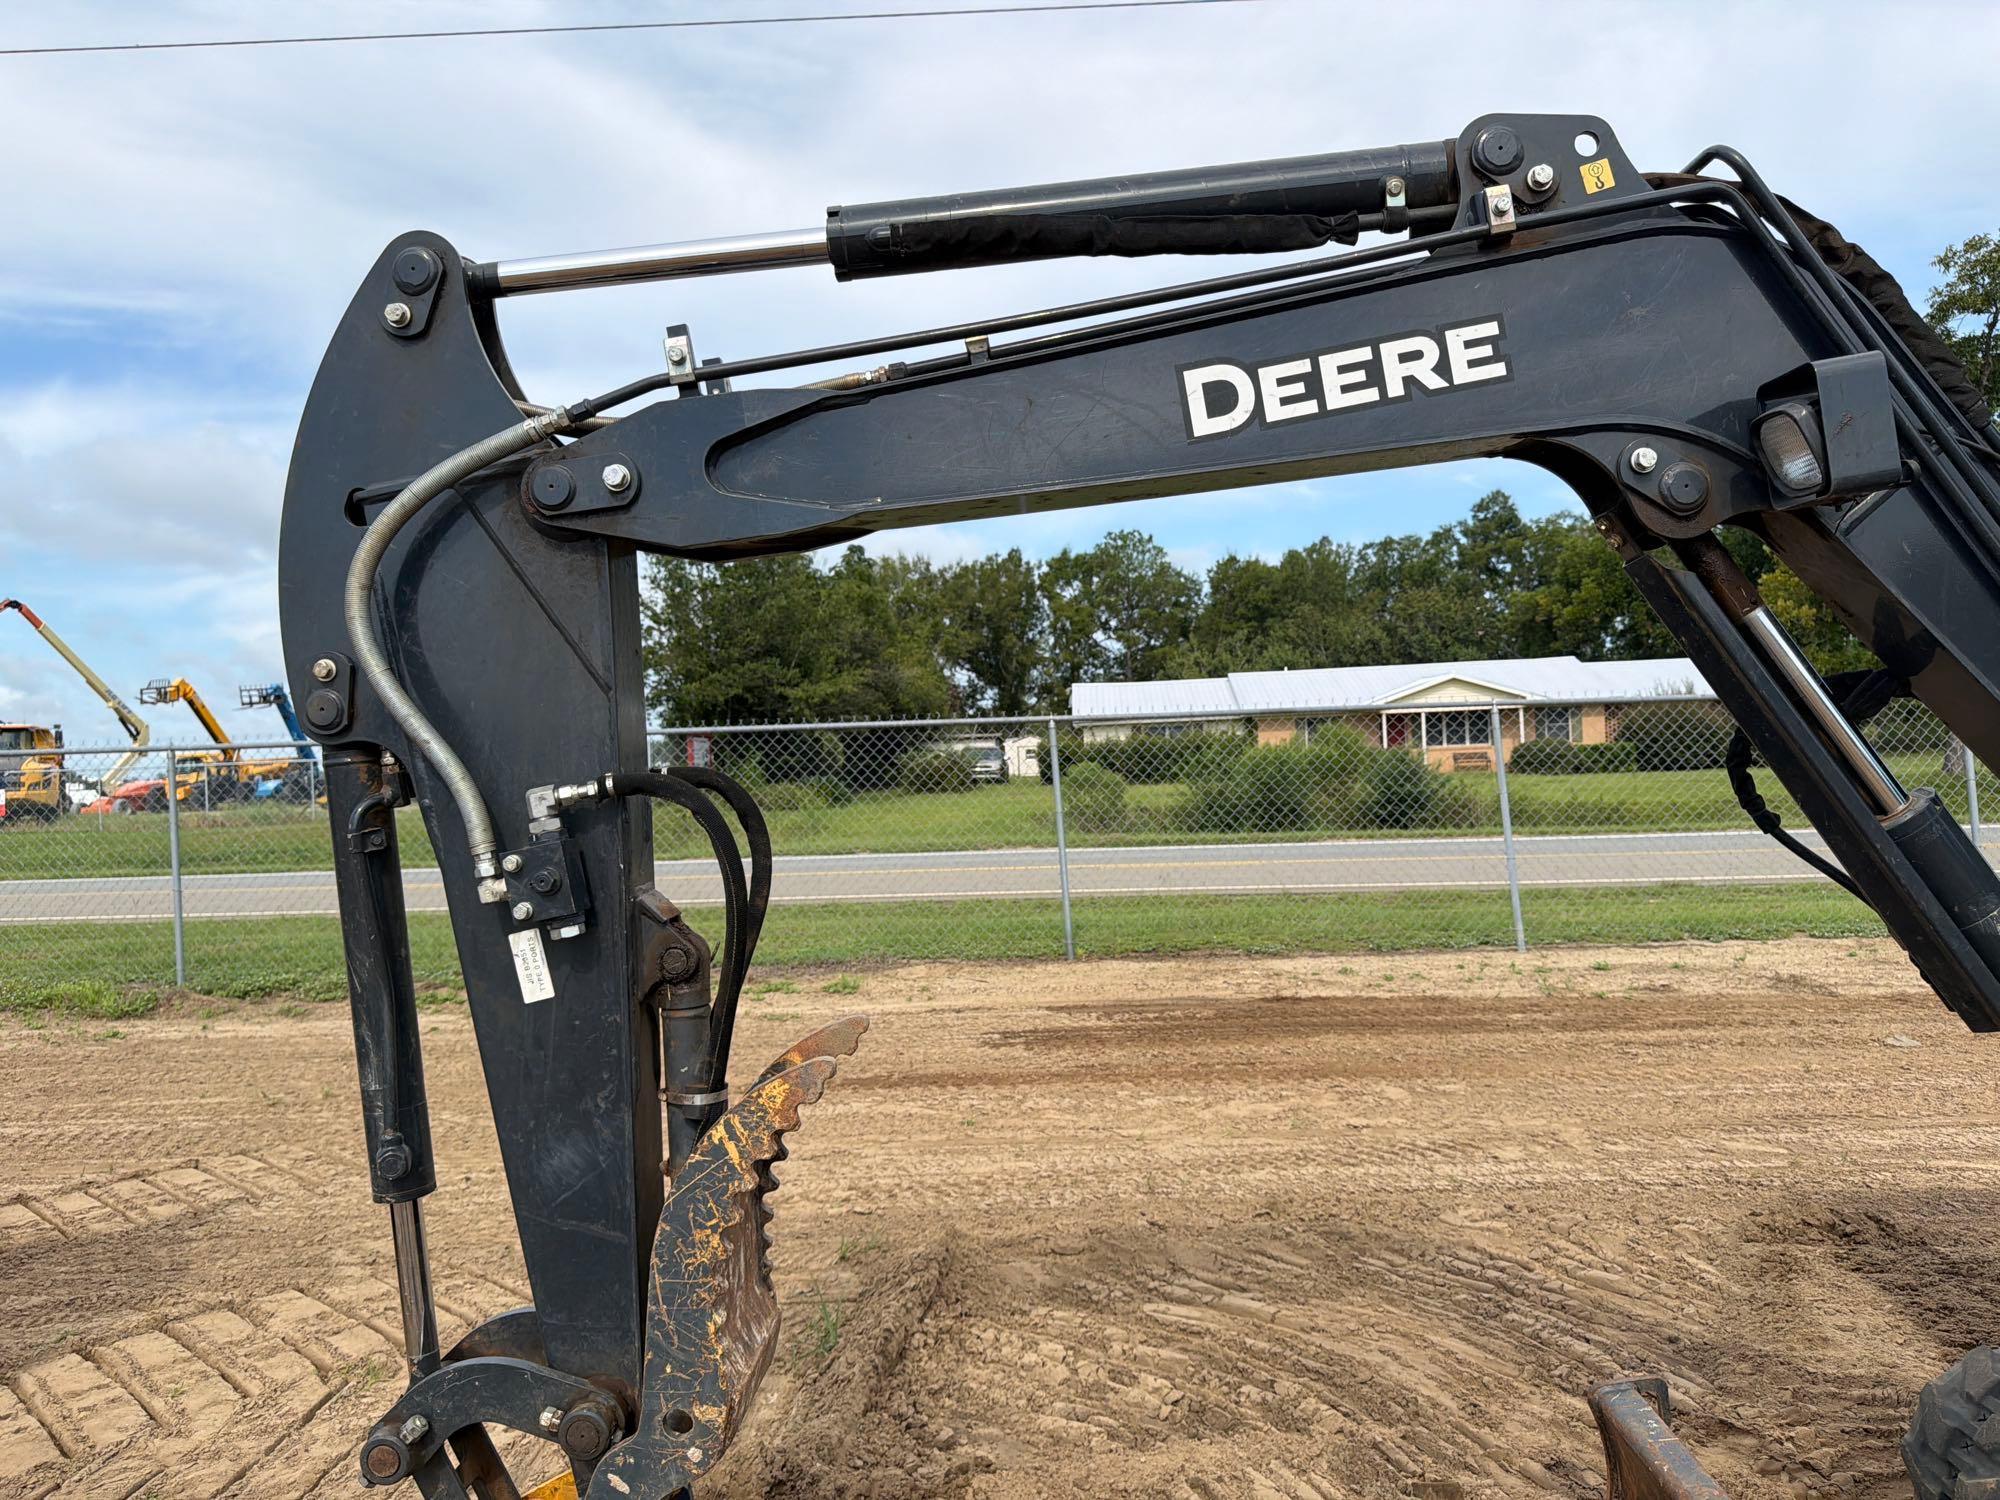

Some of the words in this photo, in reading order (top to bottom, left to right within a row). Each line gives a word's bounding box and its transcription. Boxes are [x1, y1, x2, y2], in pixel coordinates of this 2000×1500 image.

[1182, 320, 1507, 437] DEERE
[527, 936, 539, 963] PORTS
[525, 973, 534, 984] JIS
[536, 971, 546, 992] TYPE
